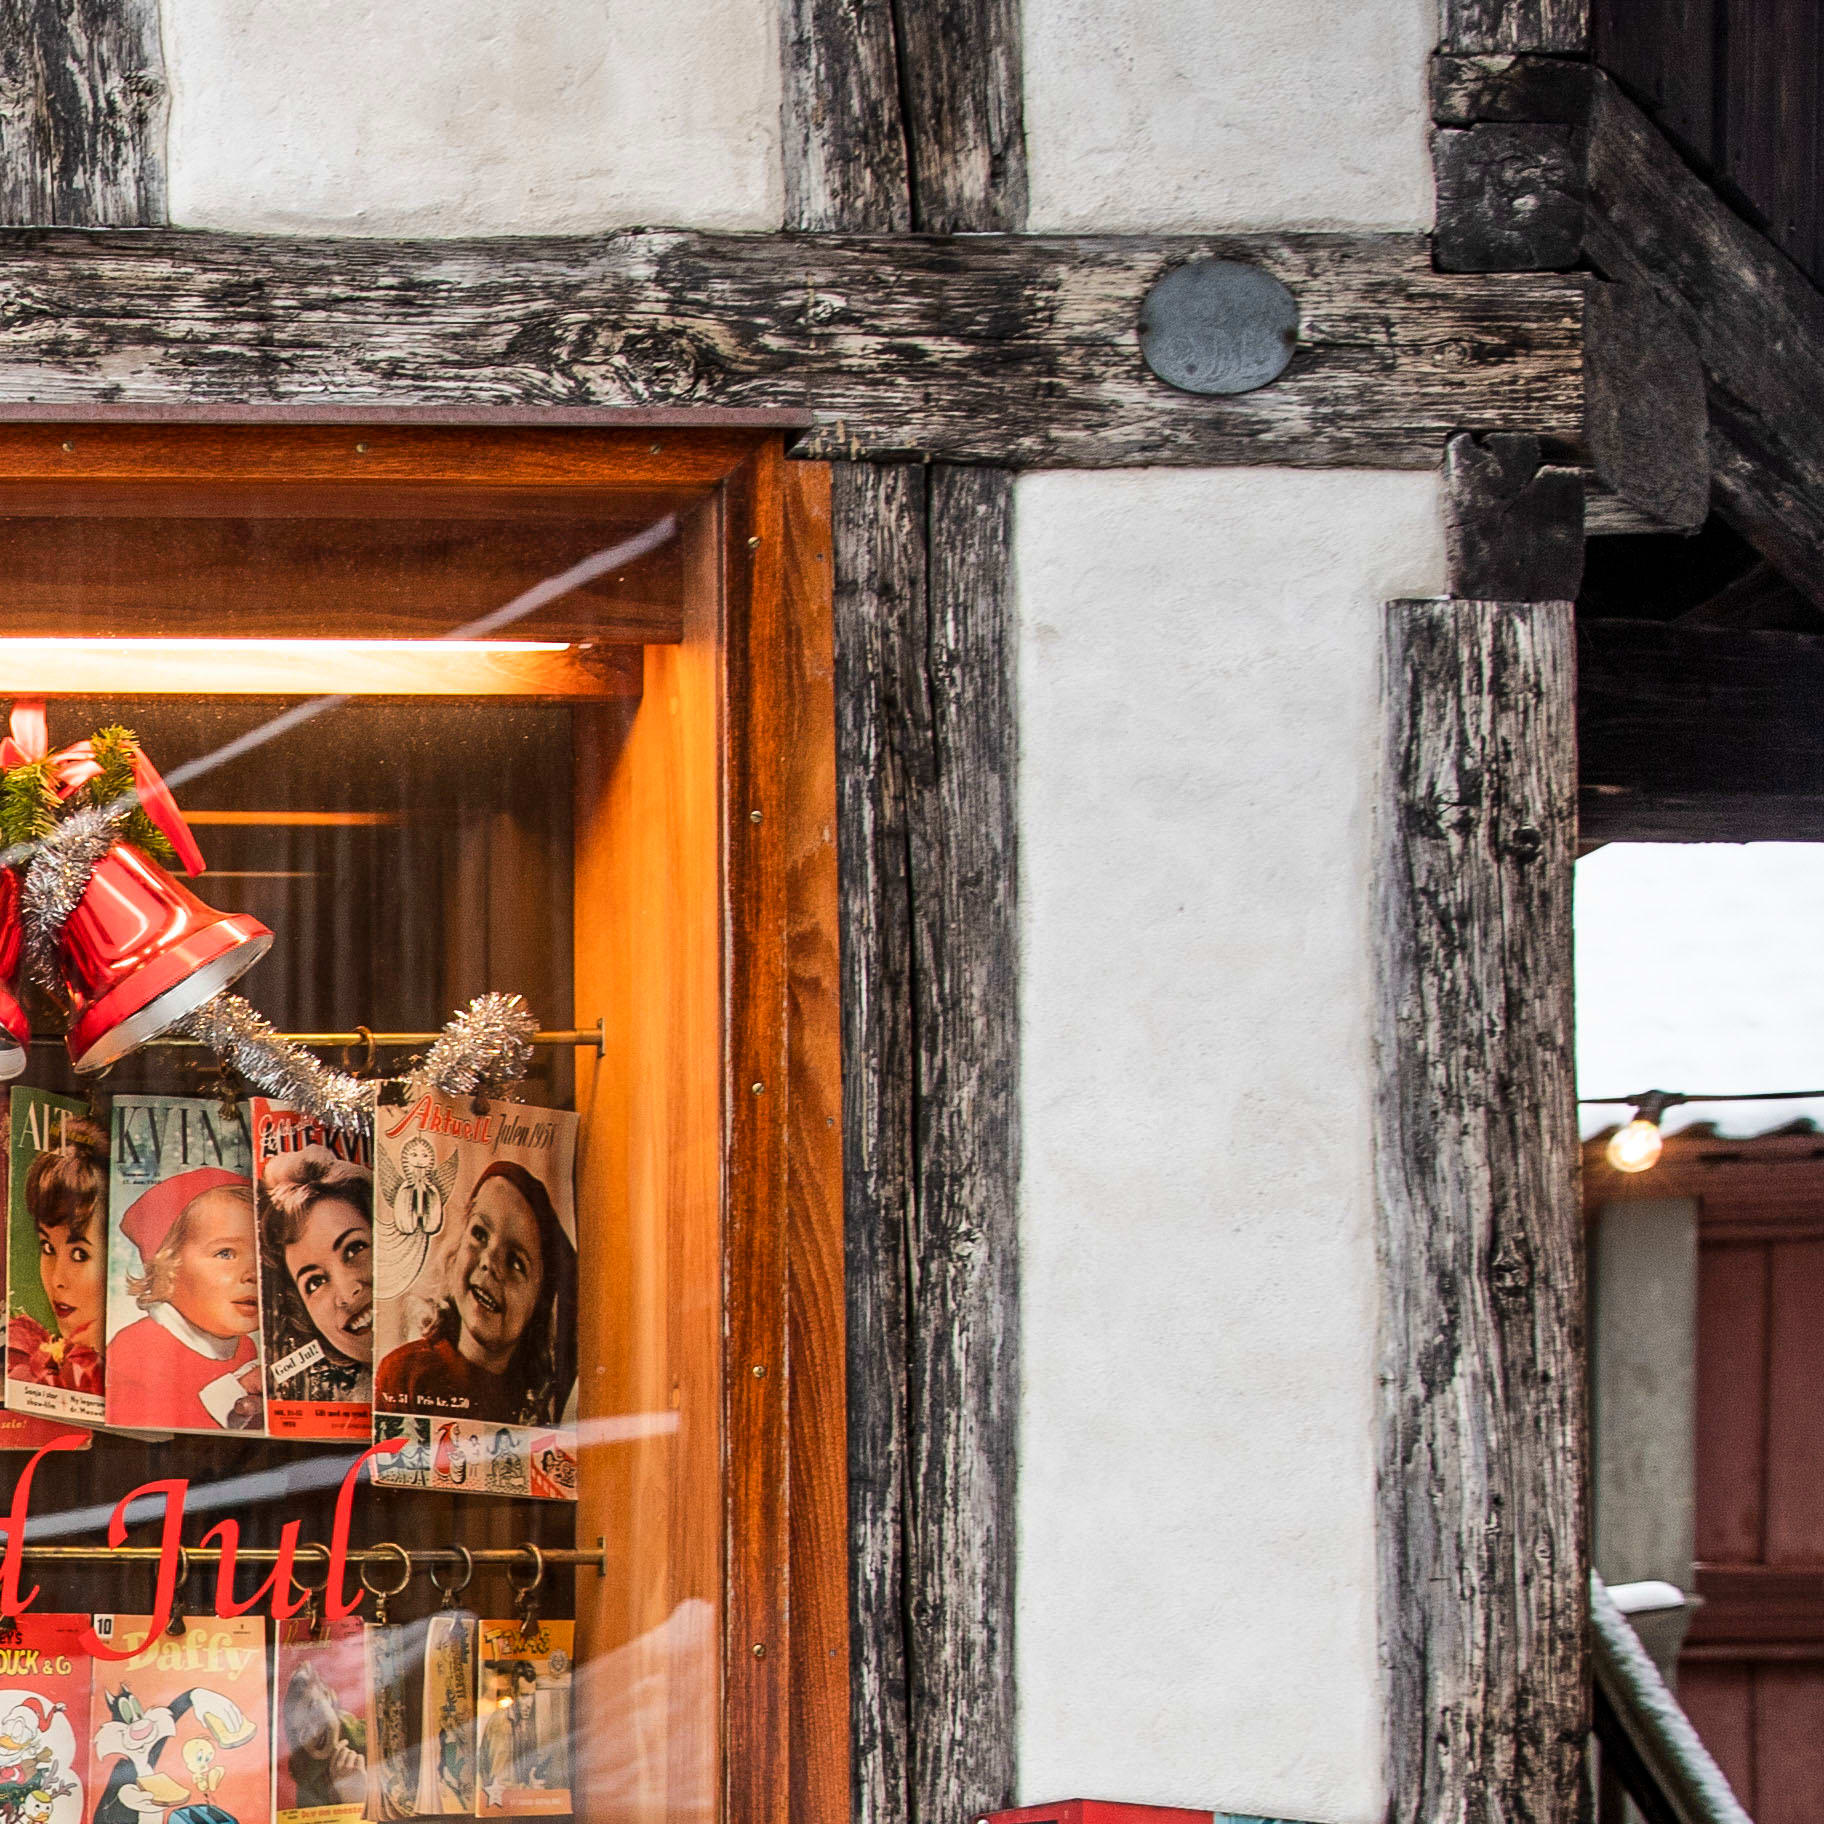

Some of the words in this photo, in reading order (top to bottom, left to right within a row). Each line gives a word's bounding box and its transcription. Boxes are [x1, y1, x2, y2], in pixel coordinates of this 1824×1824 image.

[386, 1093, 492, 1146] Aktuell
[493, 1112, 530, 1155] Julen
[274, 1357, 297, 1377] God
[297, 1344, 320, 1366] Jul!
[78, 1437, 410, 1662] Jul
[96, 1617, 113, 1636] 10
[42, 1659, 53, 1674] &
[122, 1629, 258, 1681] Daffy
